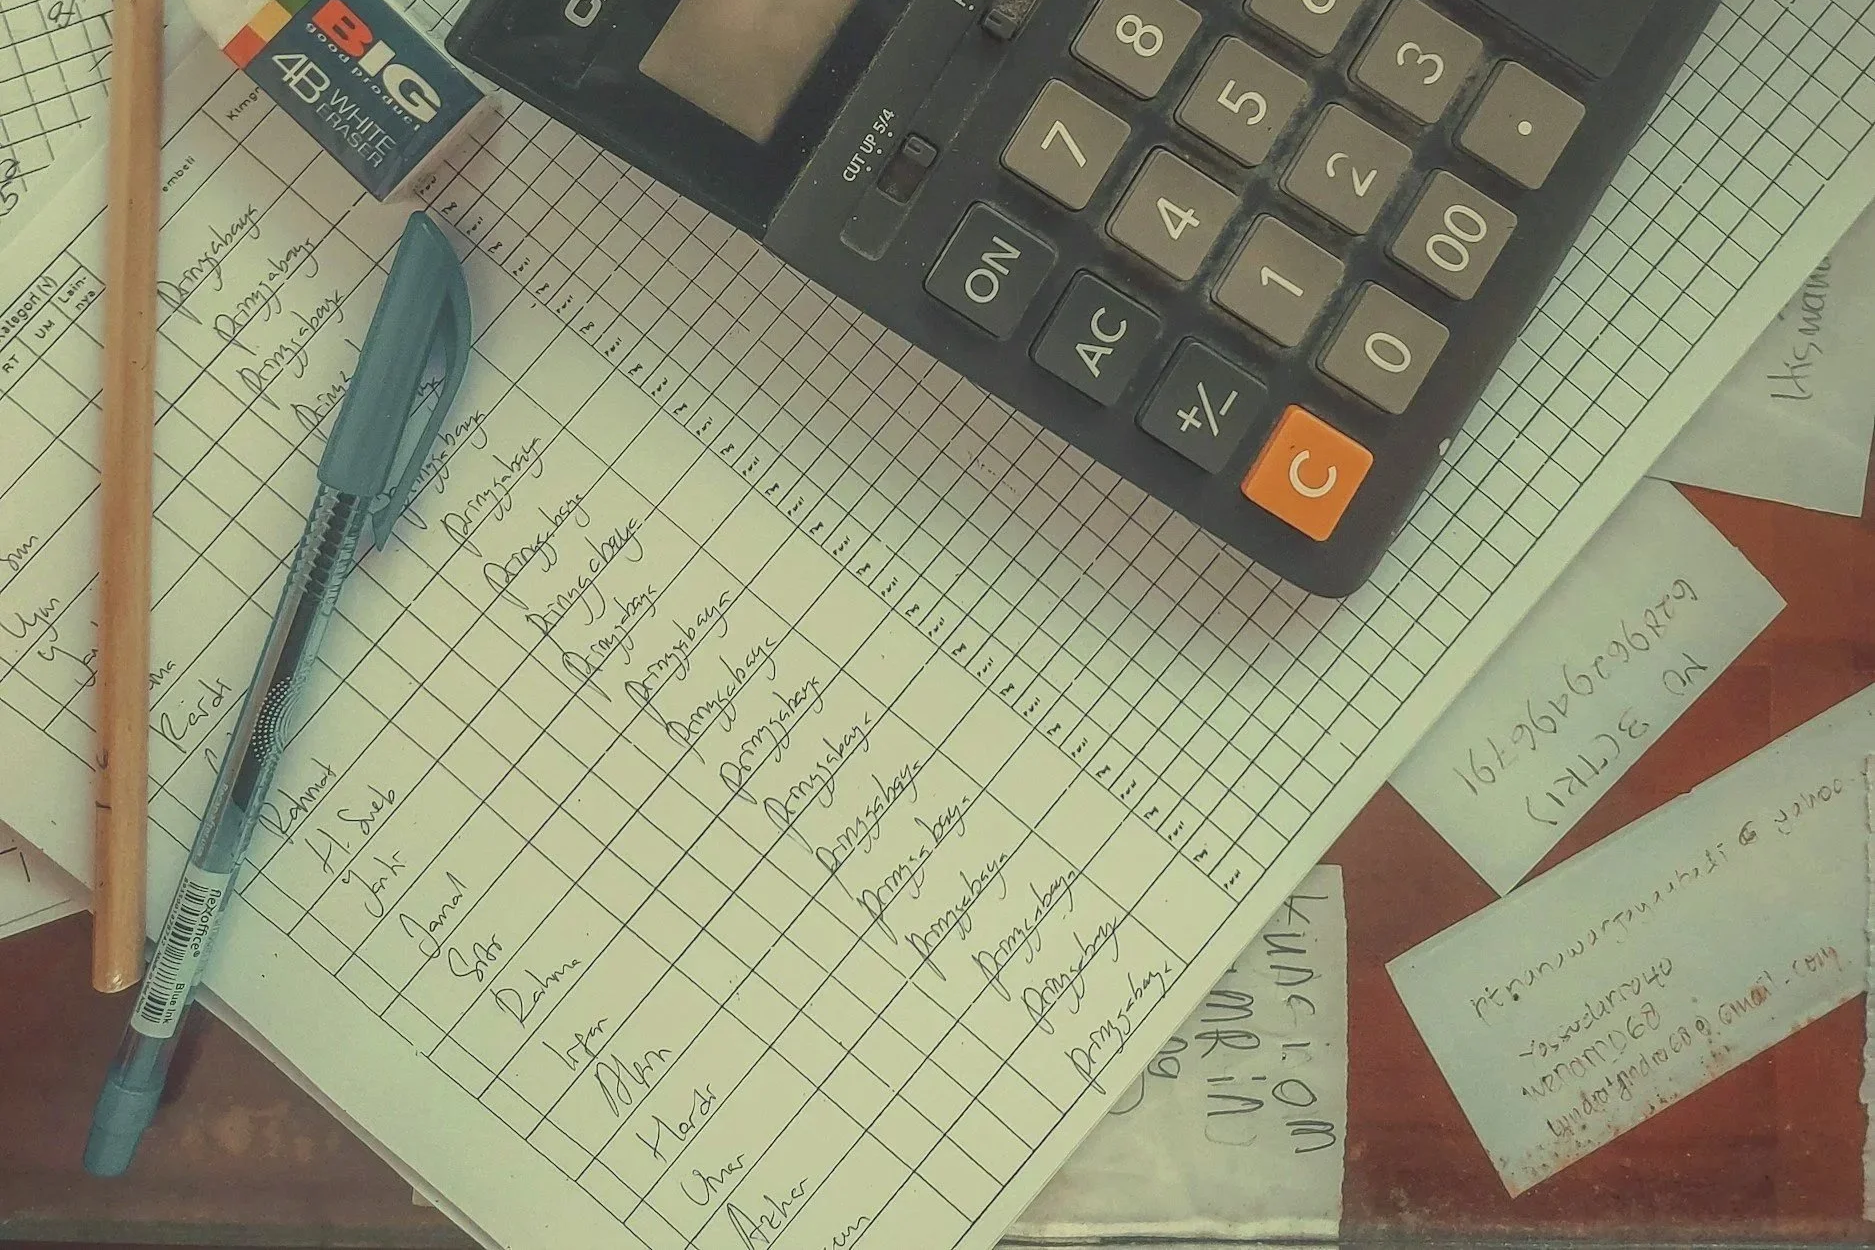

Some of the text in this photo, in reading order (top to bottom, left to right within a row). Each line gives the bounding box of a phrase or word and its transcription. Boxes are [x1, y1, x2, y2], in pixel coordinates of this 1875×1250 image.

[1115, 14, 1164, 57] 8
[272, 52, 331, 104] 4B
[305, 22, 421, 132] good product
[1397, 40, 1445, 86] 3
[329, 88, 396, 152] WHITE
[1217, 79, 1267, 125] 5
[316, 102, 385, 168] ERASER
[842, 107, 896, 184] CUT UP 5/4
[1041, 120, 1087, 168] 7
[1326, 151, 1377, 197] 2
[1155, 197, 1201, 241] 4
[1425, 205, 1488, 272] 00
[964, 236, 1022, 304] ON
[1262, 264, 1304, 297] 1
[34, 319, 56, 340] UM
[1074, 307, 1129, 379] AC
[1365, 332, 1412, 373] 0
[2, 354, 20, 373] RT
[1177, 383, 1239, 437] +/-
[1289, 450, 1338, 499] C
[162, 983, 185, 1024] Blue Ink
